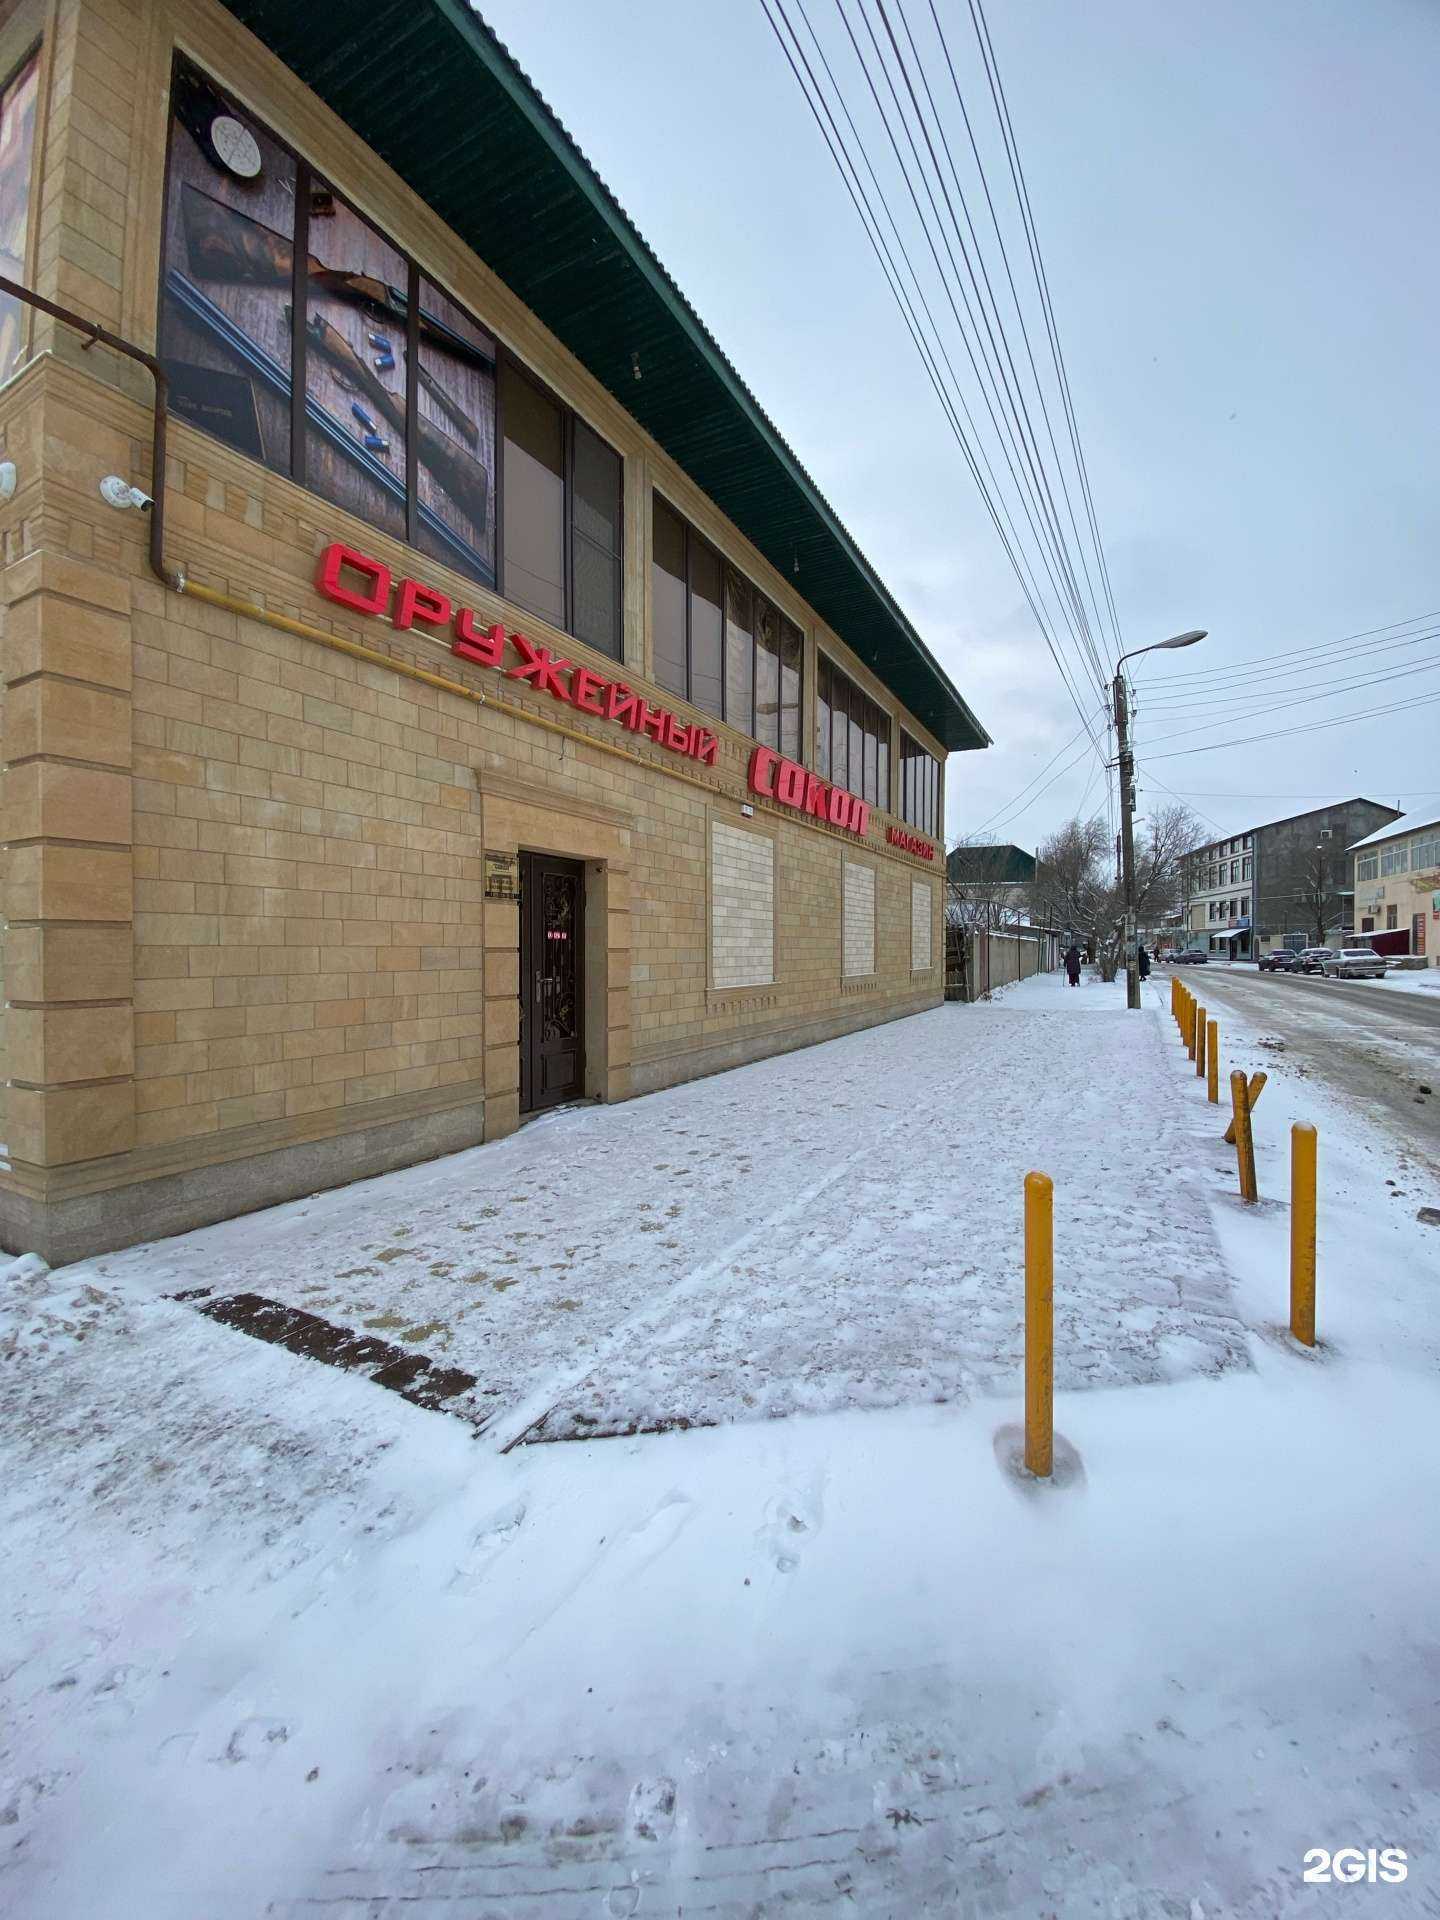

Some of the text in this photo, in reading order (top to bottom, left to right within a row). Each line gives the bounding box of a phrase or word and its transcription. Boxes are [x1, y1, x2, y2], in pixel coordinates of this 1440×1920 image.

[316, 543, 934, 860] ОРУЖЕЙНЫЙ СОКОЛ МАГАЗИН
